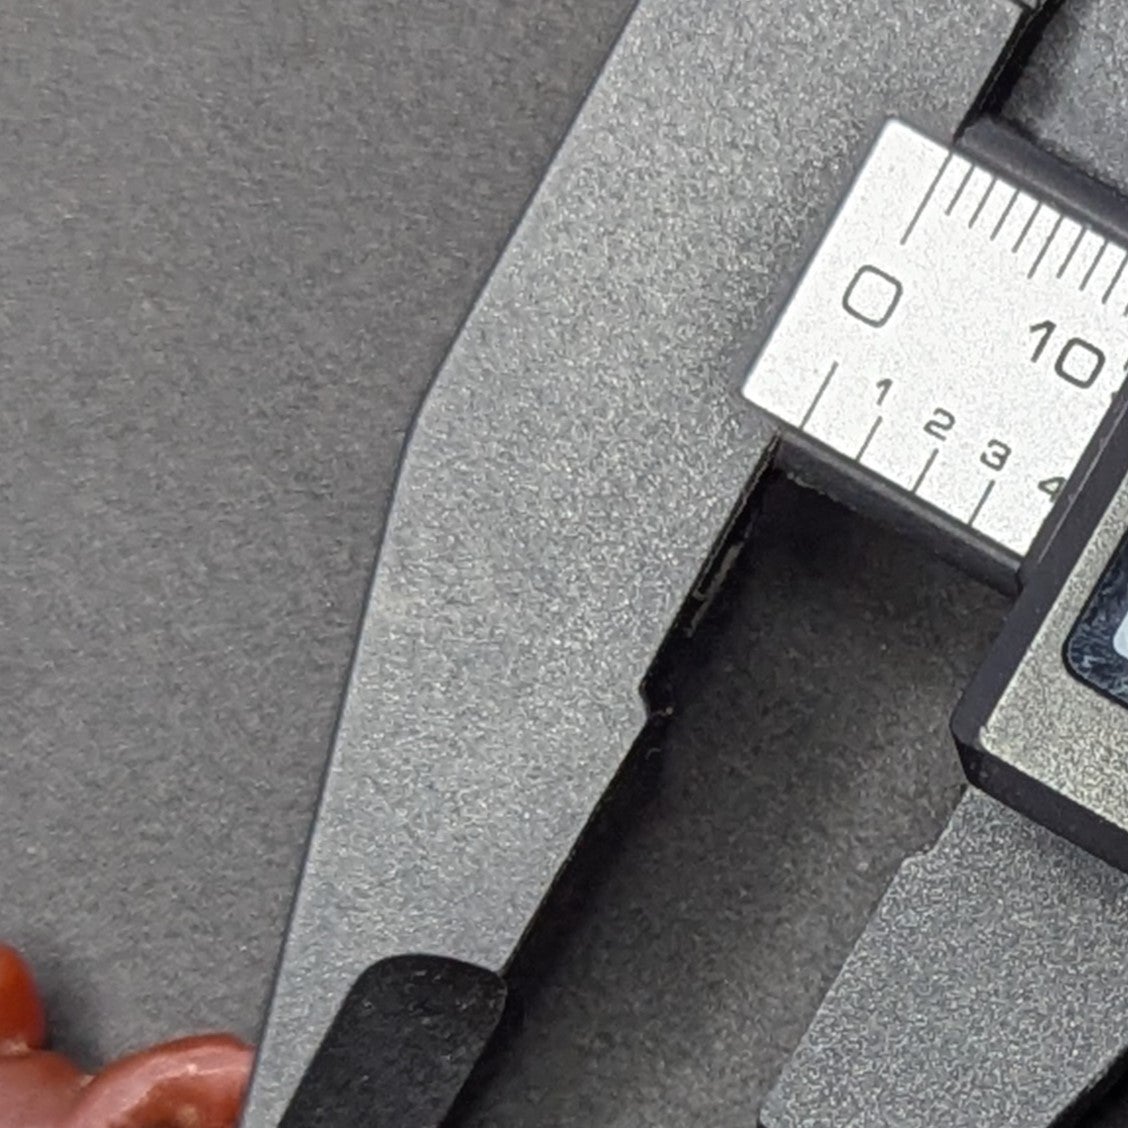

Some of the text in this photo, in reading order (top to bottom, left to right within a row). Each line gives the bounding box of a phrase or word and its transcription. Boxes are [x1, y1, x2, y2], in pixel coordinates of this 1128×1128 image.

[842, 264, 1106, 389] 0 10
[875, 378, 893, 405] 1
[923, 407, 956, 441] 2
[979, 439, 1012, 472] 3
